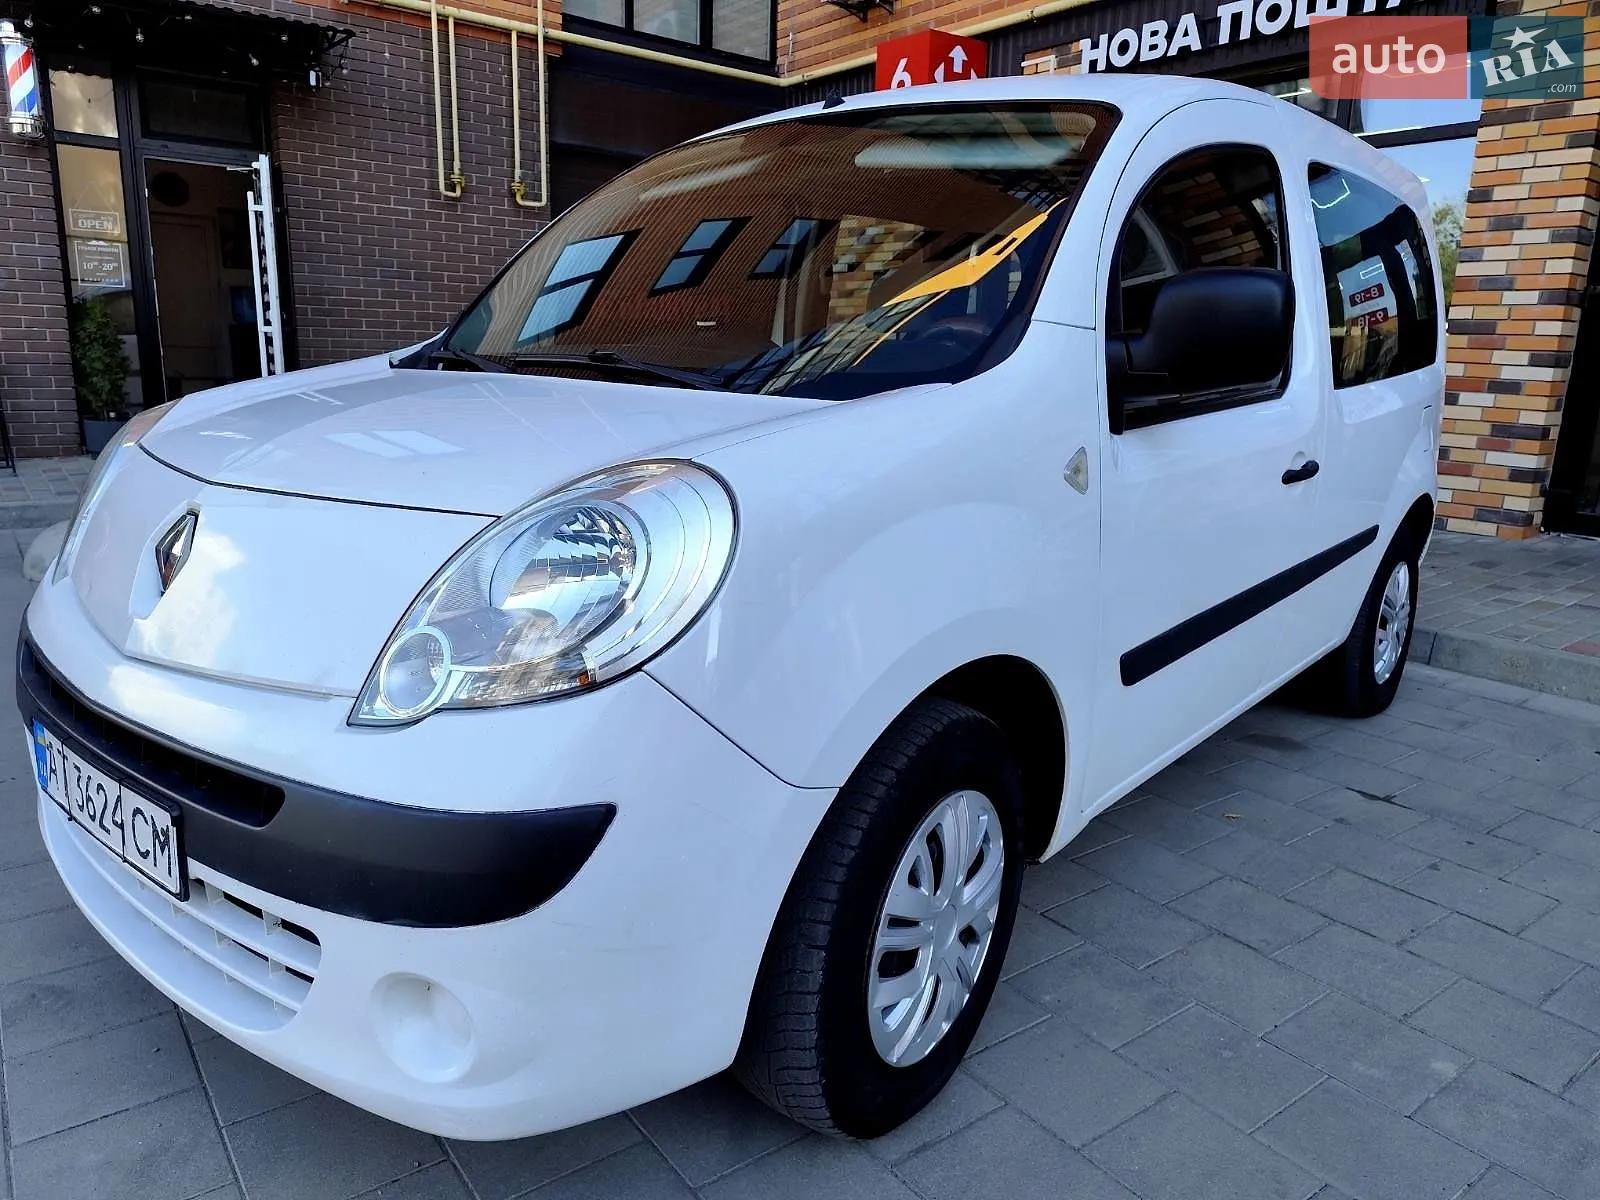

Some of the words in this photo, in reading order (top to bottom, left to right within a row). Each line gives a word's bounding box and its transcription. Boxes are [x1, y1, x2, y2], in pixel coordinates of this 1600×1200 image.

[1079, 12, 1202, 73] НОВА
[1216, 0, 1400, 45] ПОШ
[890, 57, 912, 90] 6
[78, 219, 113, 230] OPEN
[46, 741, 69, 799] AT
[73, 762, 125, 844] 3624
[131, 806, 172, 878] CM
